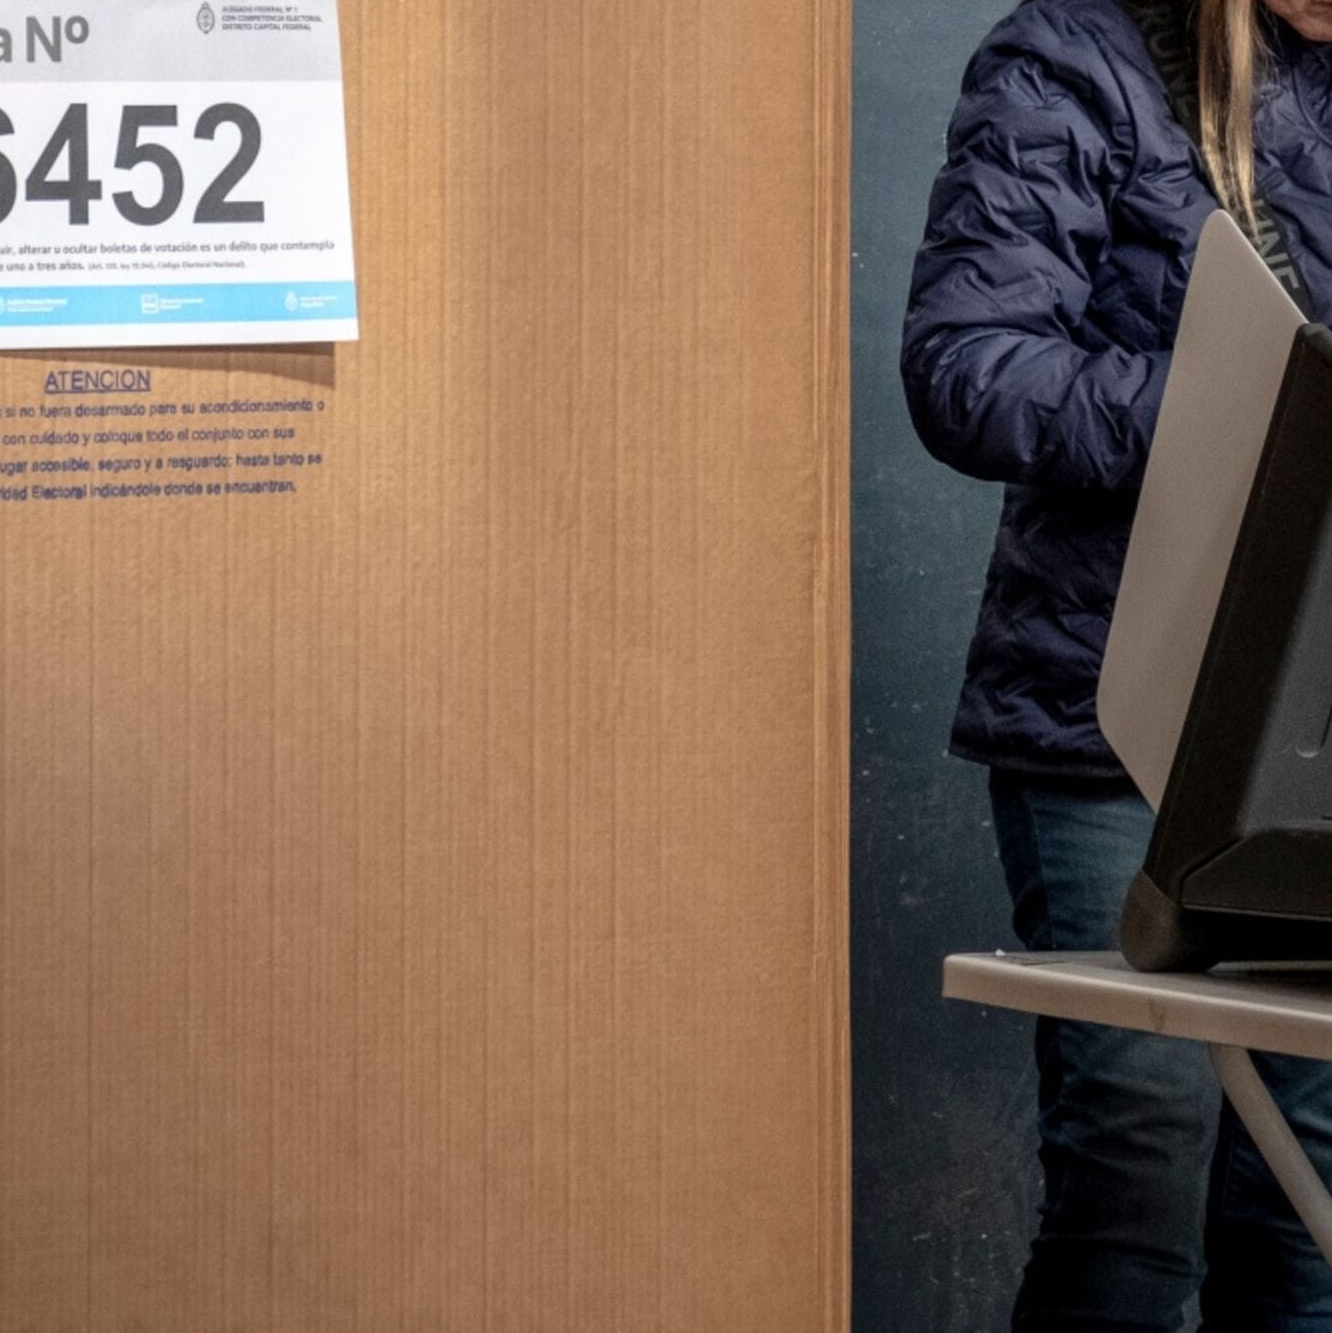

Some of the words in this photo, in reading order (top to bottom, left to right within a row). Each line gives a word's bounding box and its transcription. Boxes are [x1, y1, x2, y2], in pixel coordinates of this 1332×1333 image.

[18, 245, 52, 255] alterar
[54, 247, 61, 255] u
[63, 244, 97, 255] ocultar
[100, 243, 137, 254] boletas
[140, 242, 153, 253] de
[154, 241, 198, 253] votación
[200, 244, 211, 252] es
[214, 243, 227, 252] un
[229, 240, 258, 252] delito
[260, 242, 278, 254] que
[280, 240, 335, 253] contempla
[6, 263, 26, 272] uno
[28, 263, 35, 272] a
[37, 262, 56, 272] tres
[44, 369, 151, 392] ATENCION
[6, 405, 15, 418] si
[19, 406, 35, 417] no
[40, 404, 71, 417] fuera
[75, 402, 146, 417] desarmado
[150, 404, 177, 417] para
[181, 403, 195, 415] su
[200, 398, 313, 415] acondicionamiento
[317, 401, 325, 411] o
[2, 434, 25, 446] con
[30, 430, 79, 445] cuidado
[82, 433, 90, 446] y
[94, 430, 143, 445] coloque
[146, 429, 174, 443] todo
[178, 428, 189, 442] el
[192, 426, 245, 443] conjunto
[247, 427, 268, 439] con
[273, 427, 295, 439] sus
[98, 458, 141, 473] seguro
[144, 458, 152, 472] y
[156, 458, 163, 469] a
[235, 453, 269, 467] hasta
[273, 453, 305, 467] tanto
[308, 453, 322, 465] se
[31, 484, 87, 499] Electoral
[90, 480, 161, 498] indicándole
[164, 480, 203, 496] donde
[206, 482, 221, 495] se
